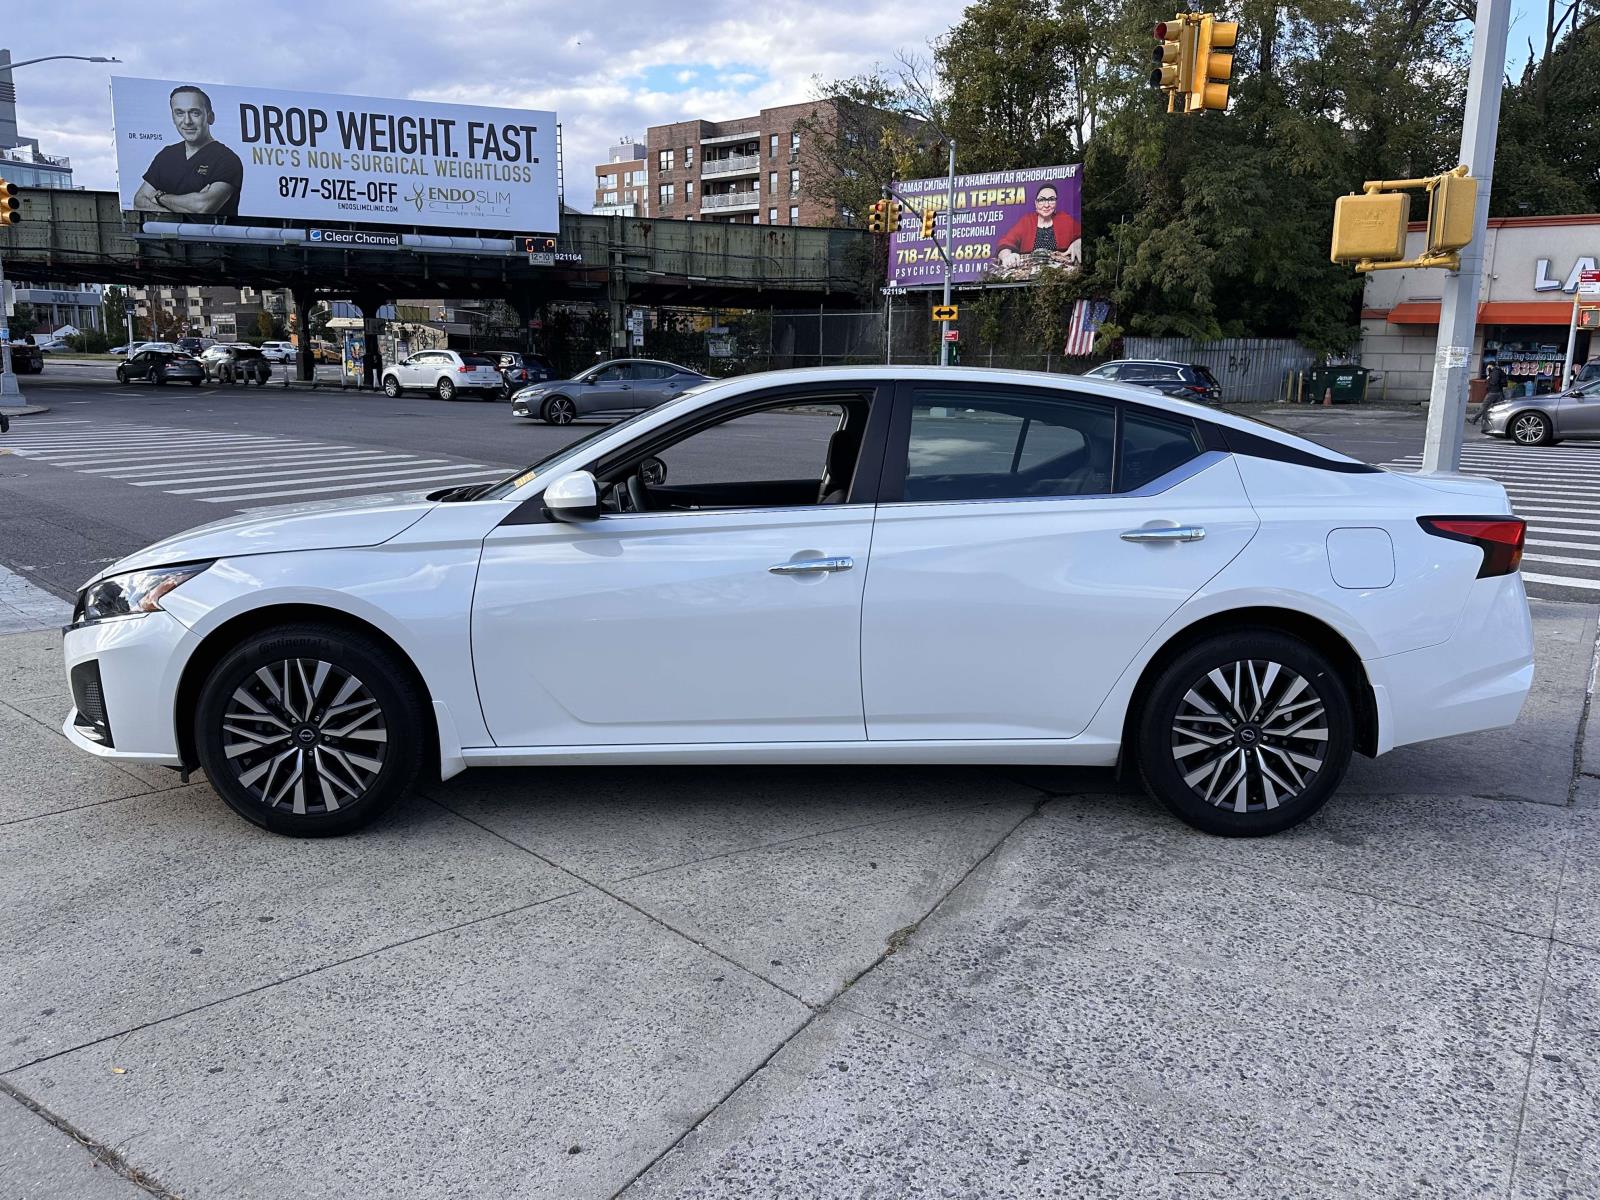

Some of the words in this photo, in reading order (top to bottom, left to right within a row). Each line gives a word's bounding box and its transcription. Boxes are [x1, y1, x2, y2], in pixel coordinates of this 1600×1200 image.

[139, 132, 163, 141] SHAPSIS
[240, 103, 328, 147] DROP
[336, 110, 459, 158] WEIGHT.
[467, 121, 540, 164] FAST.
[252, 146, 301, 167] NYC'S
[308, 151, 429, 176] NON-SURGICAL
[434, 159, 532, 183] WEIGHTLOSS
[898, 182, 923, 194] САМАЯ
[924, 178, 957, 192] СИЛЬНЯ
[958, 177, 964, 187] И
[965, 172, 1014, 187] ЗНАМЕНИТАЯ
[1015, 166, 1076, 183] ЯСНОВИДЯЩАЯ
[279, 176, 398, 204] 877-SIZE-OFF
[428, 187, 511, 205] ENDOSLIM
[970, 186, 1026, 208] ТЕРЕЗА
[337, 202, 398, 213] ENDOSLIMCLINIC.COM
[977, 210, 1004, 223] СУДЕБ
[324, 231, 353, 242] Clear
[354, 233, 399, 245] Channel
[555, 253, 582, 261] 921164
[895, 265, 941, 278] PSYCHICS
